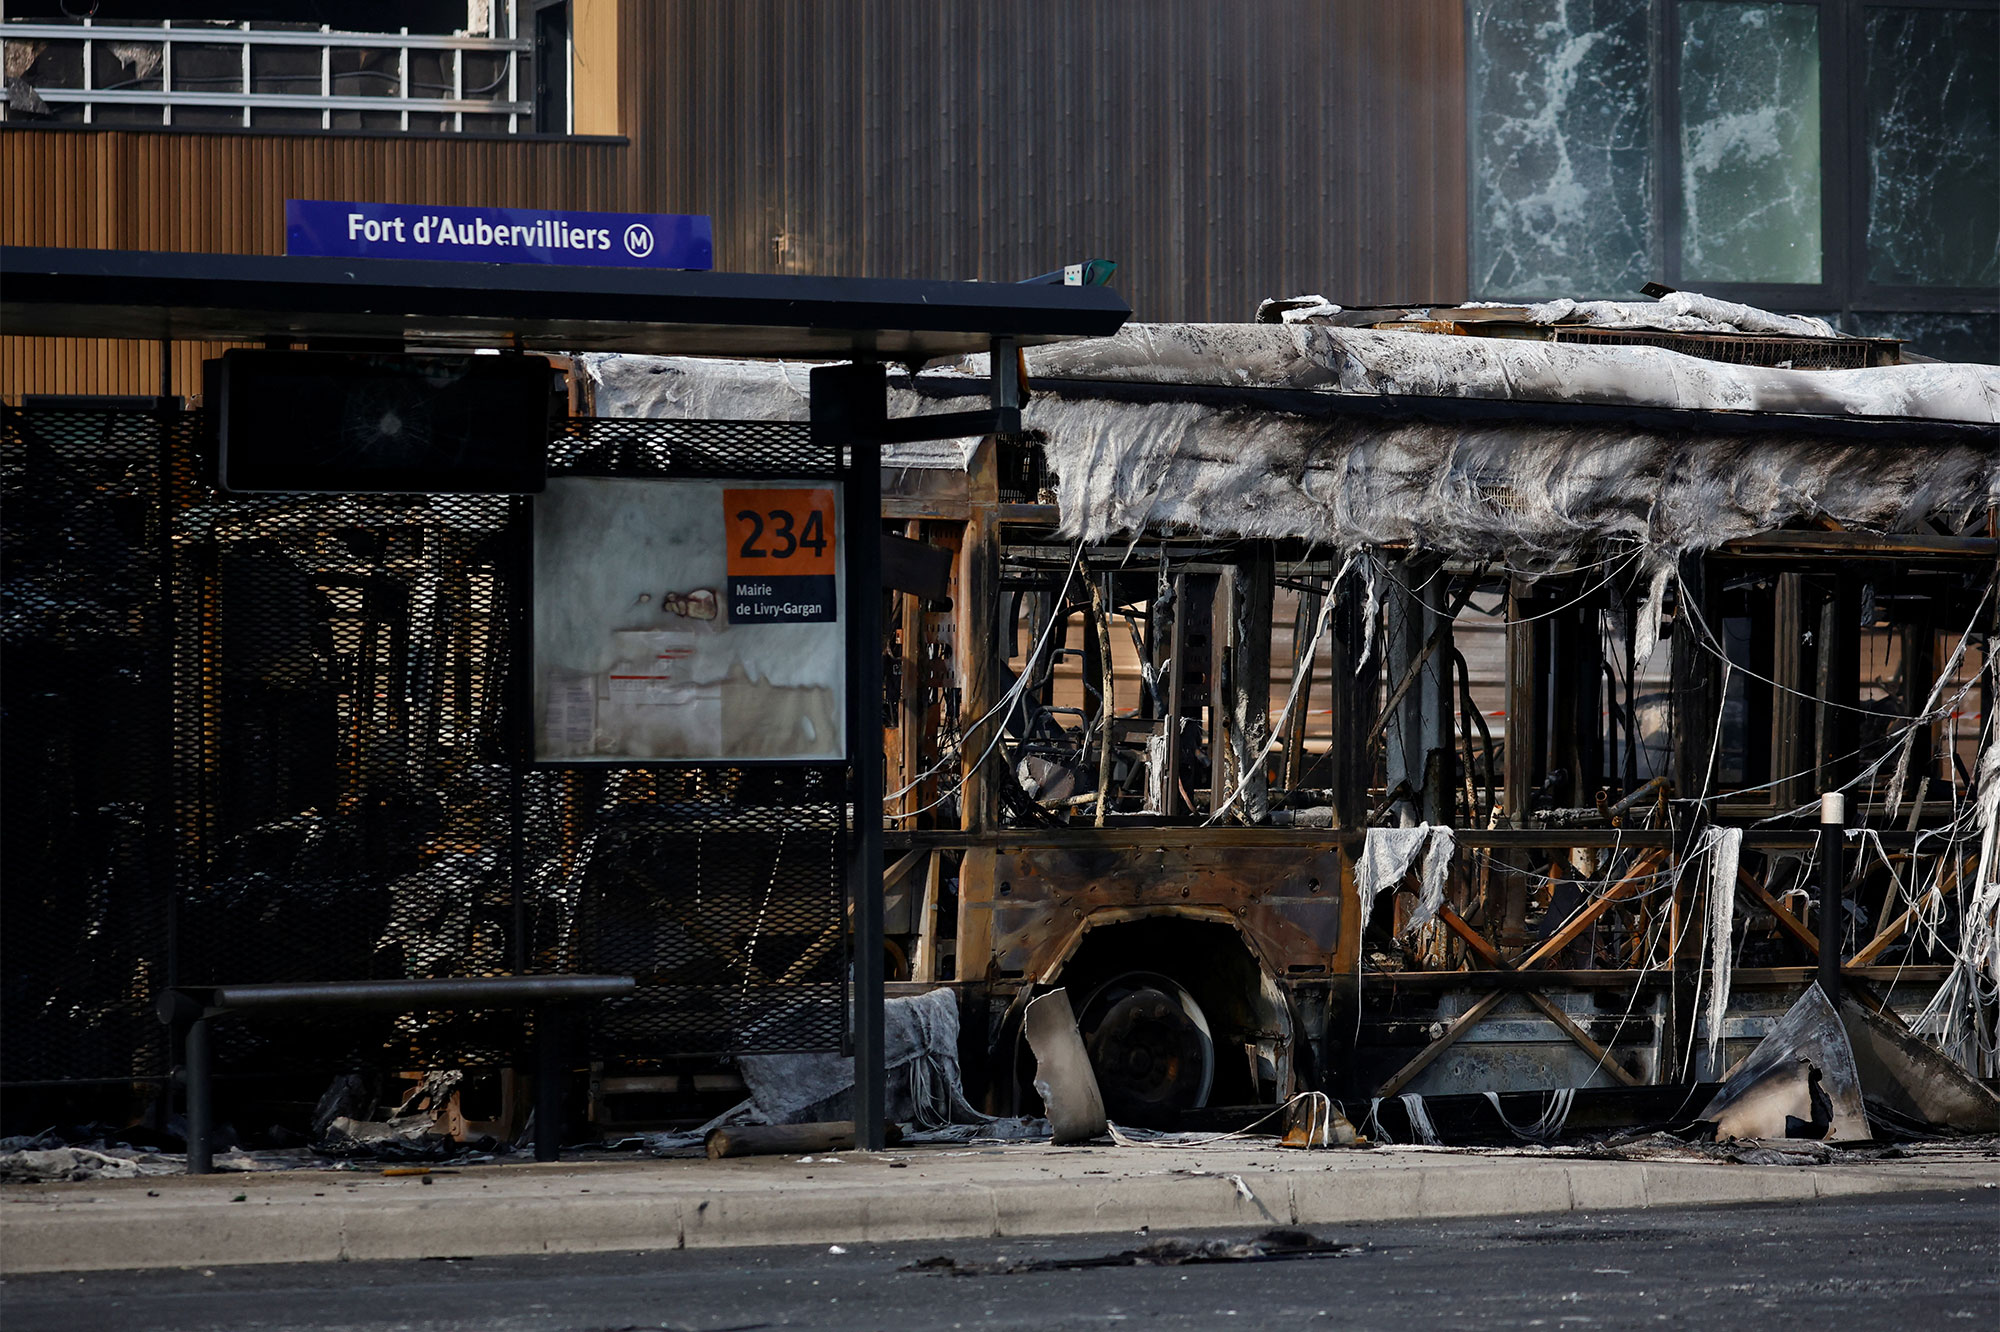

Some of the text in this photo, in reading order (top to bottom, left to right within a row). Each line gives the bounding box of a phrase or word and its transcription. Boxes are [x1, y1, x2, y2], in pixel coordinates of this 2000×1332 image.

[348, 213, 406, 243] Fort
[736, 509, 827, 558] 234
[736, 584, 772, 596] Mairie
[736, 602, 822, 617] de Livry-Gargan
